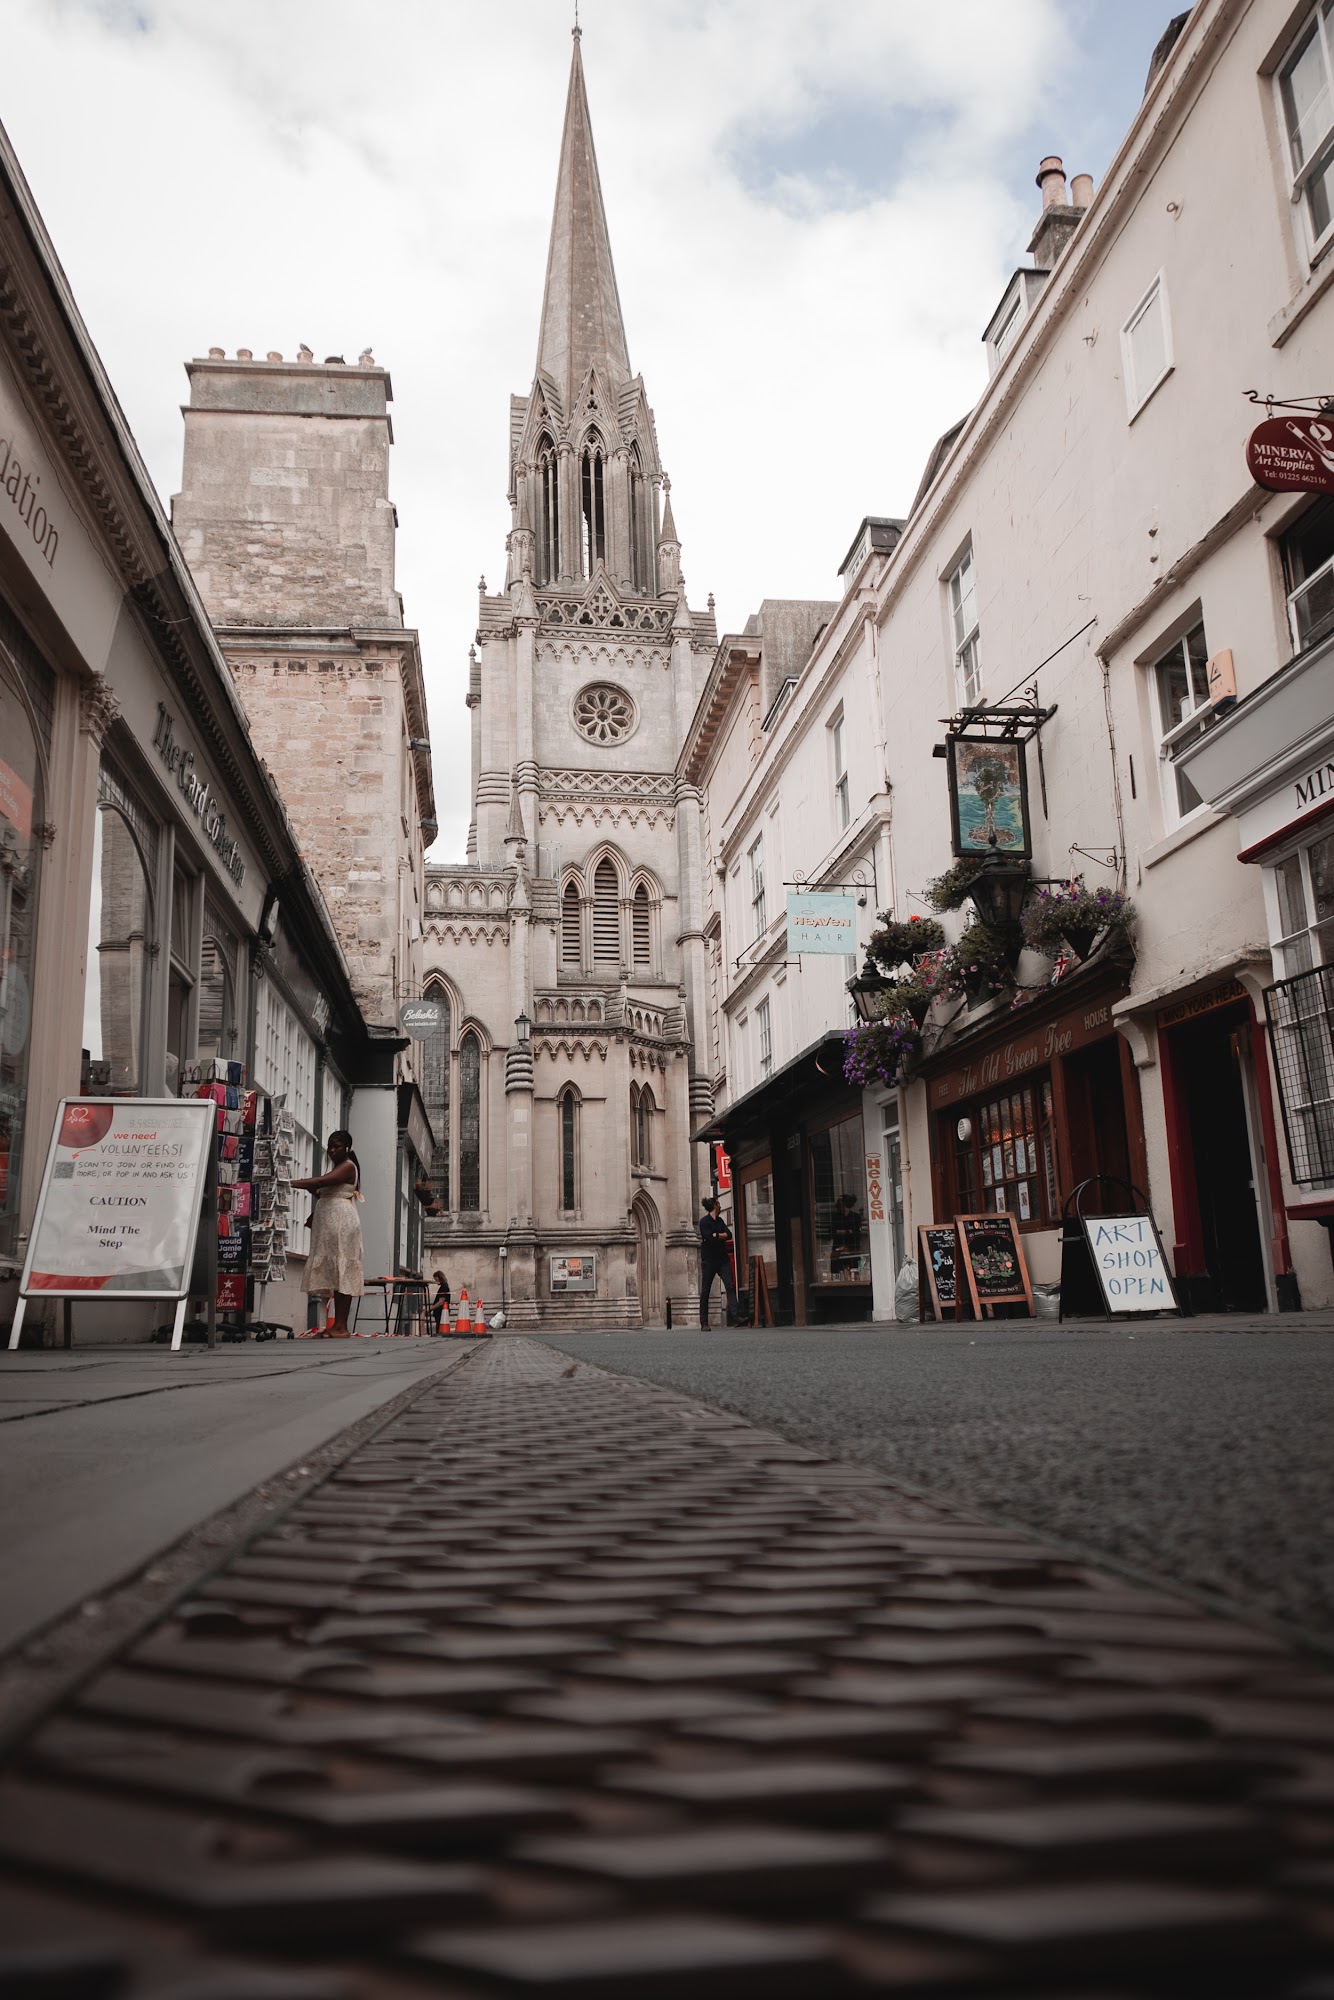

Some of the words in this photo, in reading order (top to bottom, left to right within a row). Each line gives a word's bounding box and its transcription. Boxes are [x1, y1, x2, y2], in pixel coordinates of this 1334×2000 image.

[1253, 444, 1314, 461] MINERVA
[1255, 455, 1272, 466] Art
[1273, 456, 1315, 471] Supplies
[1264, 470, 1278, 478] Tel:
[1279, 471, 1300, 481] 01225
[154, 700, 181, 772] The
[177, 750, 210, 820] Card
[202, 797, 246, 888] Collection
[801, 932, 843, 942] HAIR
[1186, 993, 1214, 1015] YOUR
[1084, 1007, 1108, 1031] HOUSE
[958, 1065, 977, 1096] The
[981, 1054, 1000, 1086] Old
[1004, 1044, 1039, 1075] Green
[1044, 1023, 1073, 1058] Tree
[938, 1083, 949, 1097] FREE
[113, 1132, 129, 1140] we
[131, 1131, 157, 1140] need
[100, 1143, 183, 1156] VOLUNTEERS!
[78, 1161, 100, 1169] SCAN
[155, 1161, 175, 1169] FIND
[159, 1171, 175, 1179] ASK
[89, 1196, 148, 1207] CAUTION
[87, 1225, 117, 1234] Mind
[120, 1225, 140, 1234] The
[1096, 1220, 1149, 1246] ART
[99, 1238, 123, 1250] Step
[223, 1251, 238, 1259] do?
[1103, 1249, 1159, 1269] SHOP
[1109, 1276, 1164, 1295] OPEN
